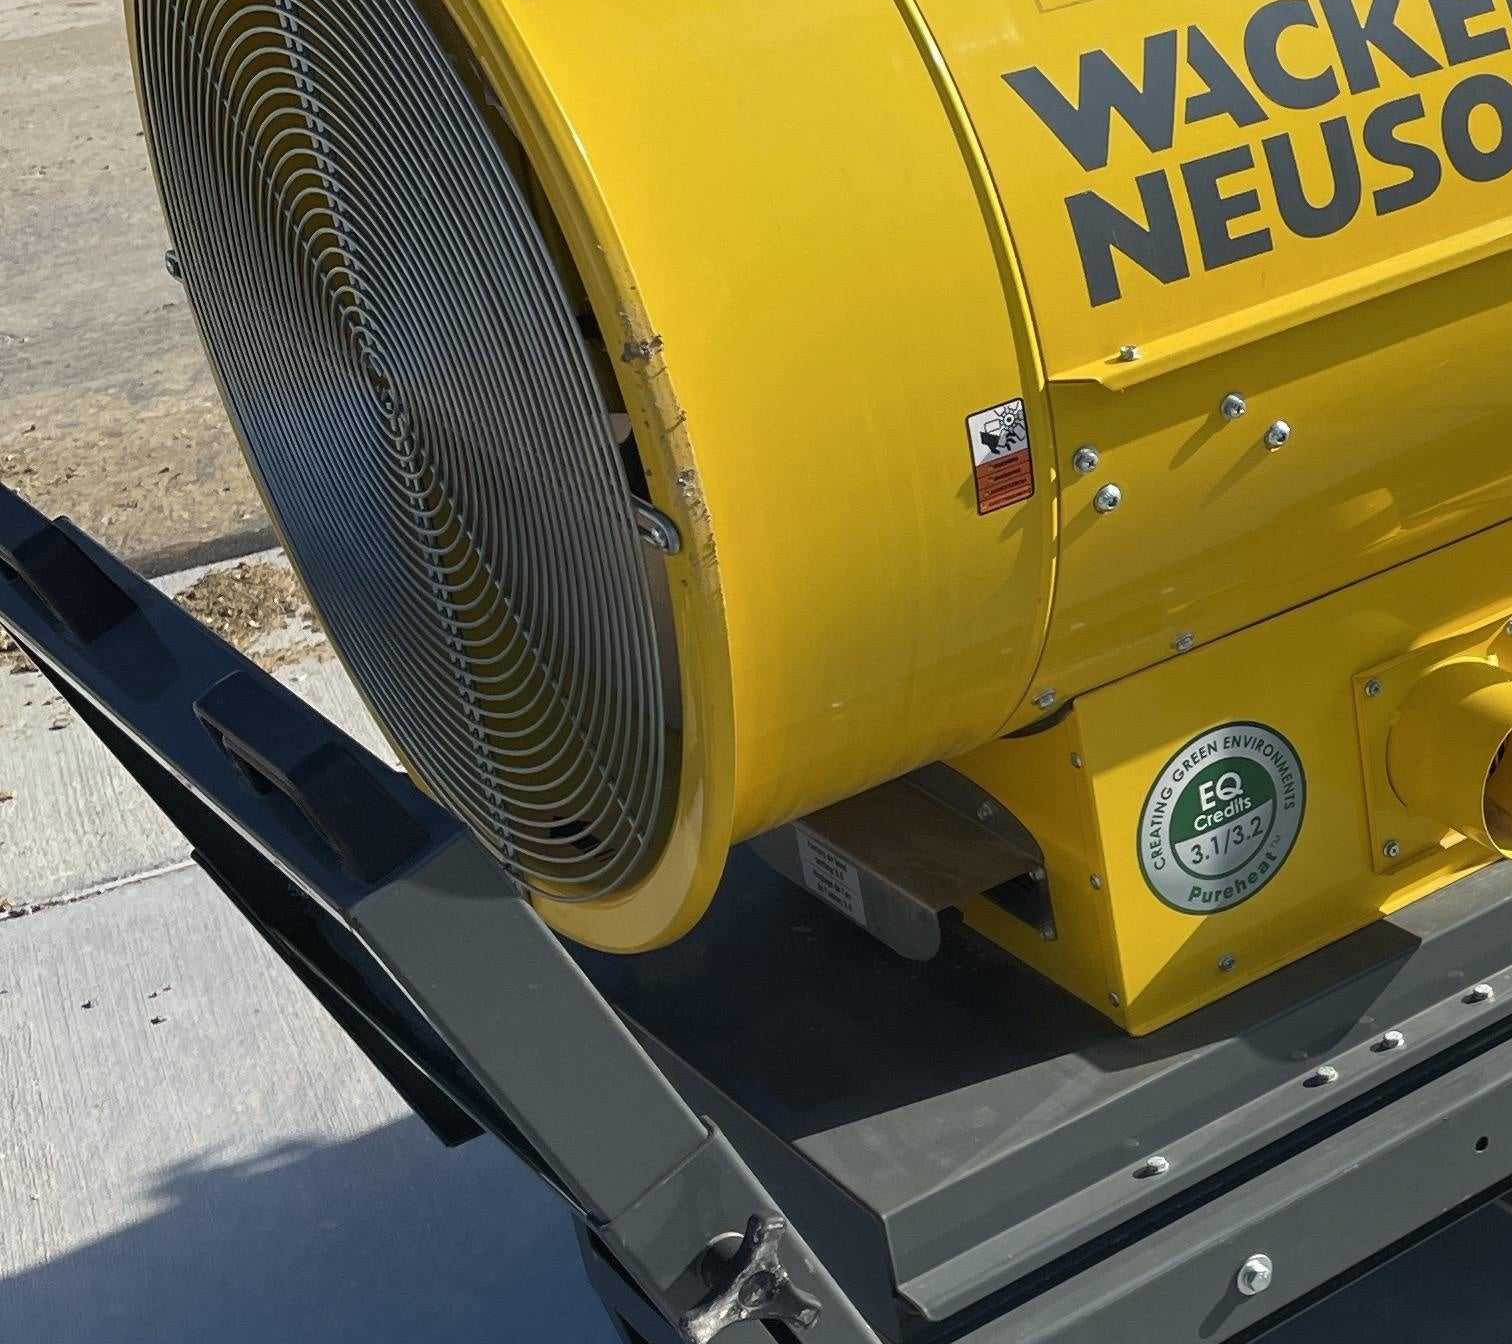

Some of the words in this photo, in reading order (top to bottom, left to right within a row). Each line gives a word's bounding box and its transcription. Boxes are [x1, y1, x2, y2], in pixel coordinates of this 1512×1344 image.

[1150, 786, 1174, 871] CREATING
[1173, 740, 1218, 783] GREEN
[1223, 735, 1296, 810] ENVIRONMENTS
[1193, 796, 1252, 831] Credits
[1199, 772, 1244, 812] EQ
[1190, 816, 1264, 865] 3.1/3.2
